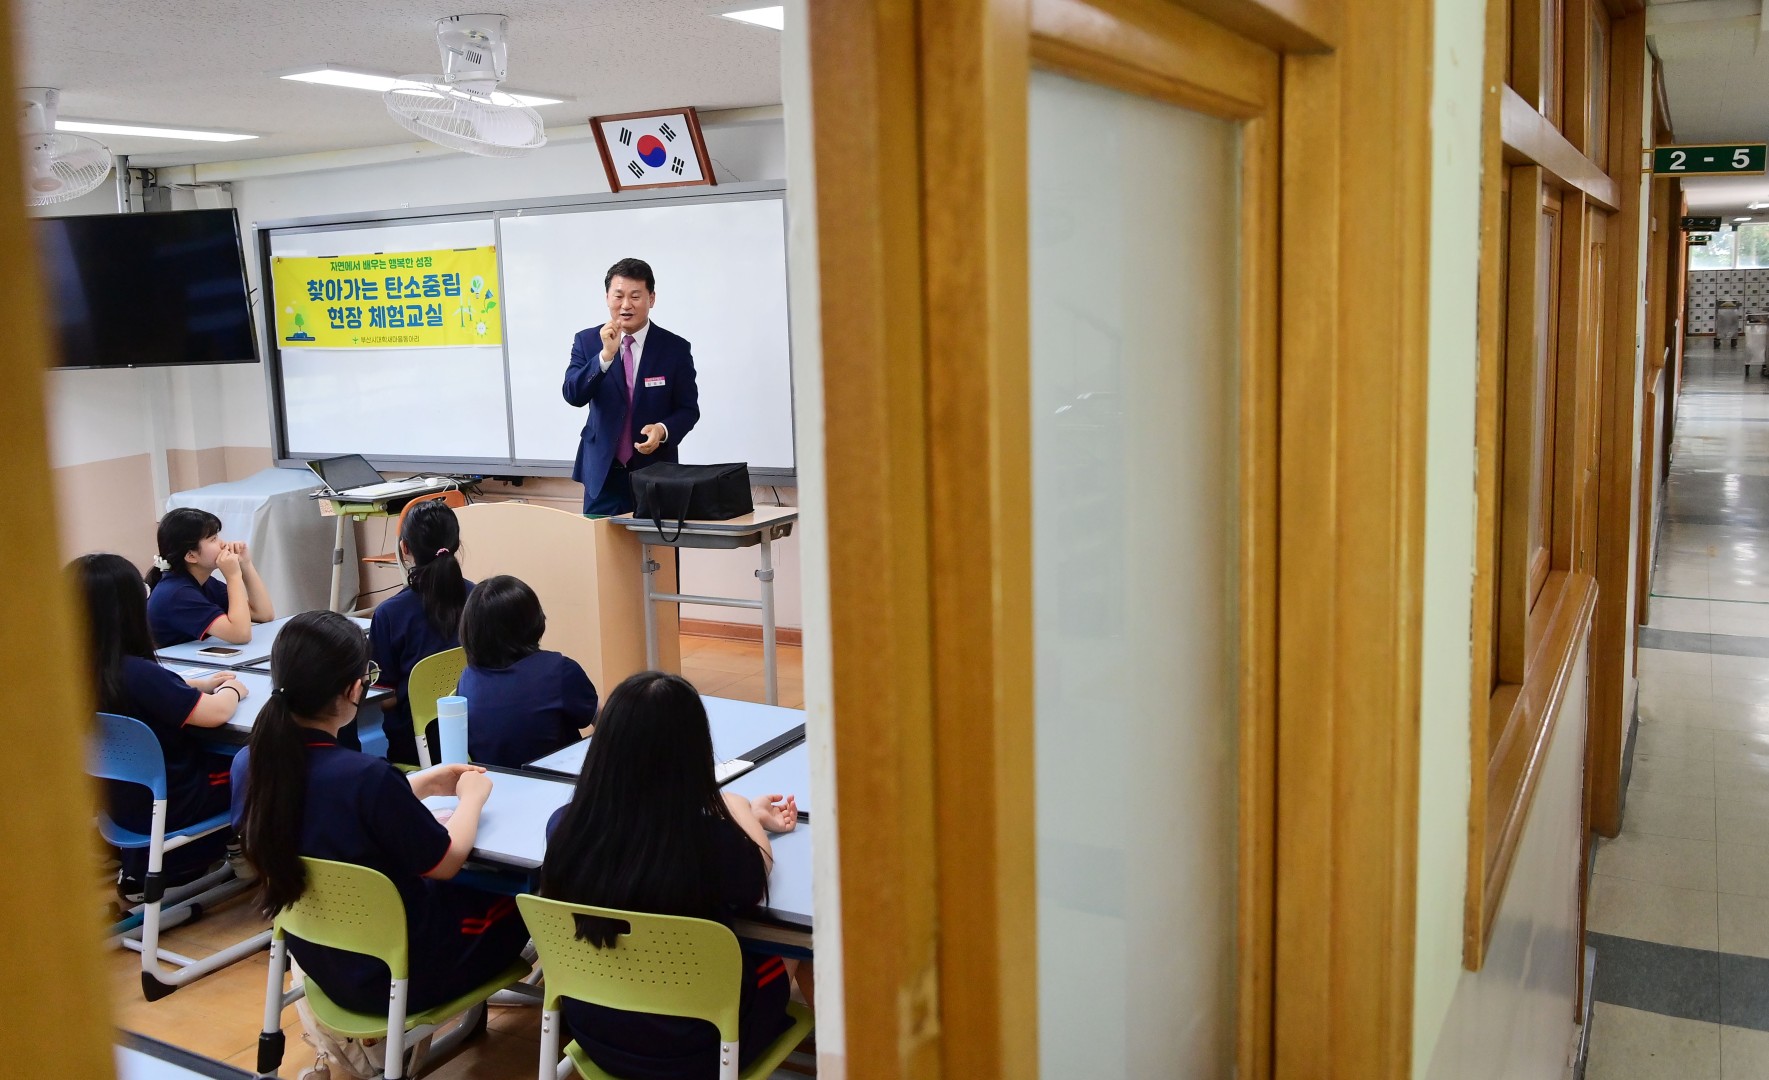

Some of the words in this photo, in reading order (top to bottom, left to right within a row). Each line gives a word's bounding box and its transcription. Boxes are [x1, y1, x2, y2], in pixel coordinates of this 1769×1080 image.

[330, 260, 361, 272] 자연에서
[362, 258, 387, 271] 배우는
[388, 257, 414, 270] 행복한
[415, 256, 433, 268] 성장
[306, 277, 379, 302] 찾아가는
[385, 272, 461, 301] 탄소중립
[327, 305, 363, 330] 현장
[368, 303, 444, 329] 체험교실
